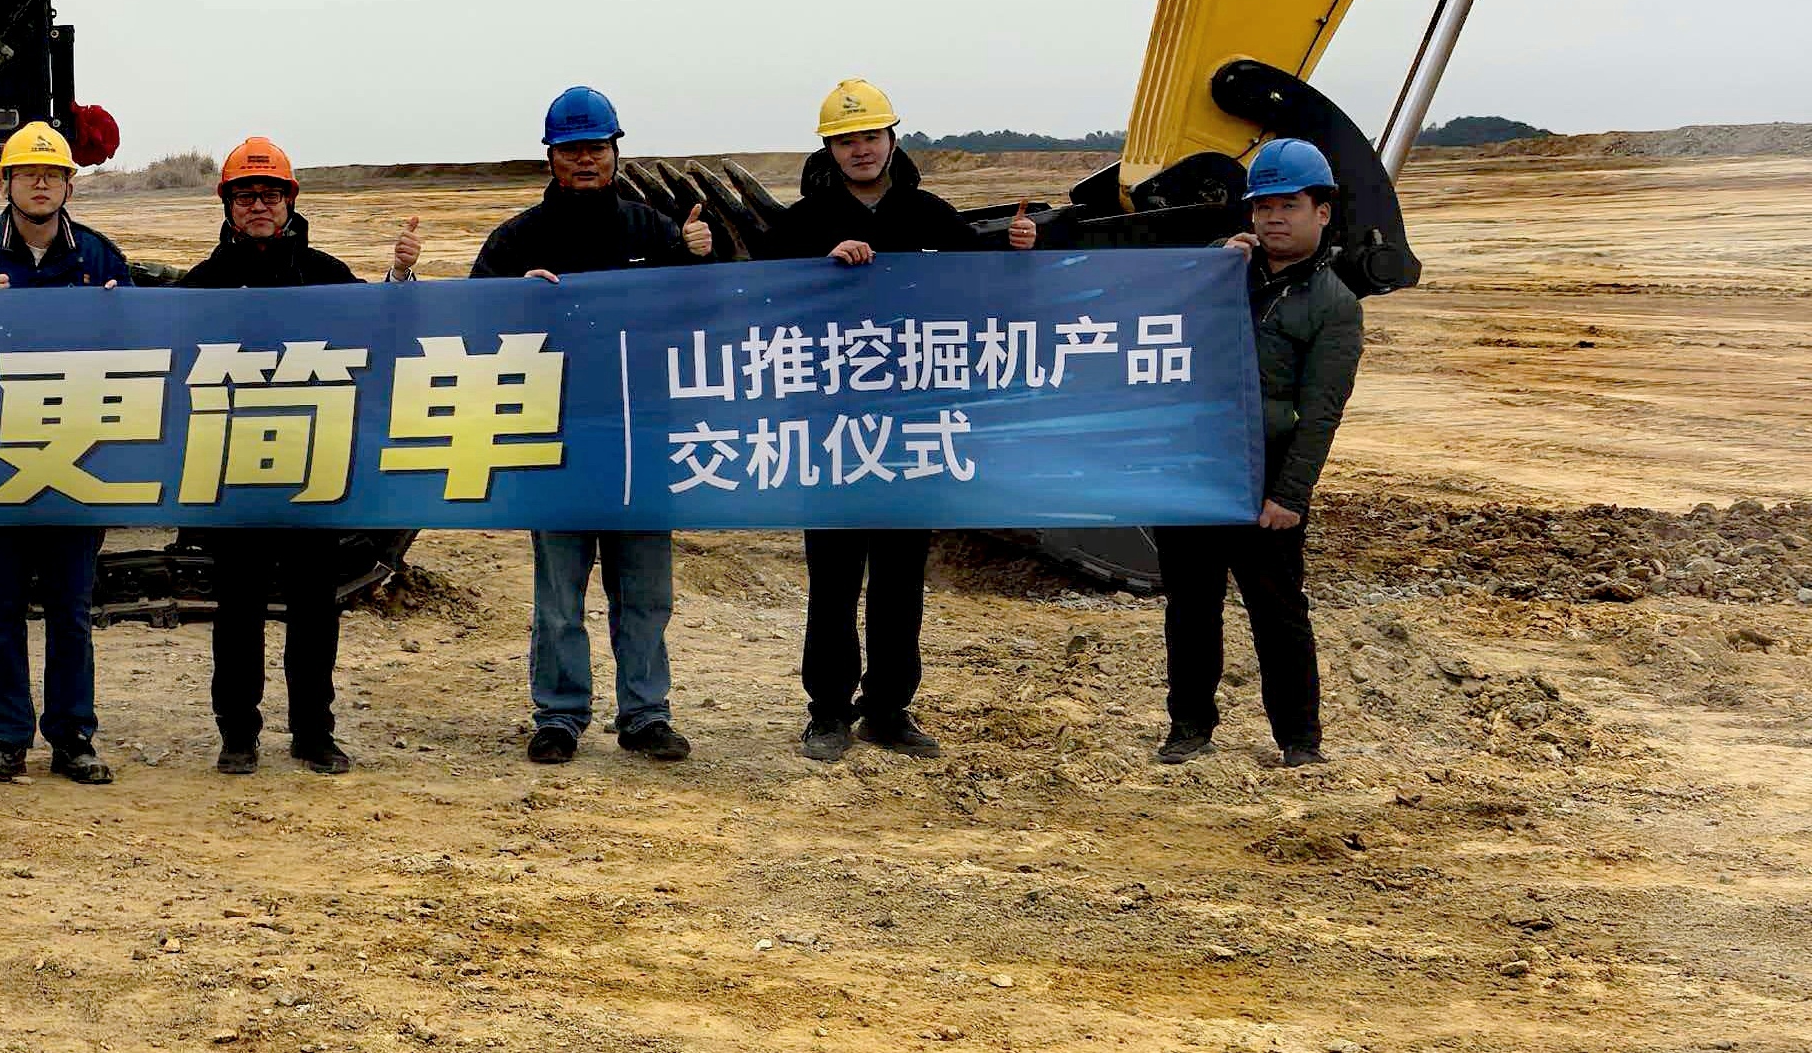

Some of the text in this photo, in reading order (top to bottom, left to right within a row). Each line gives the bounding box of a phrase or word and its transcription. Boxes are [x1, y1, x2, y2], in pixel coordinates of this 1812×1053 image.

[666, 314, 1192, 402] 山推挖掘机产品
[667, 410, 976, 494] 交机仪式
